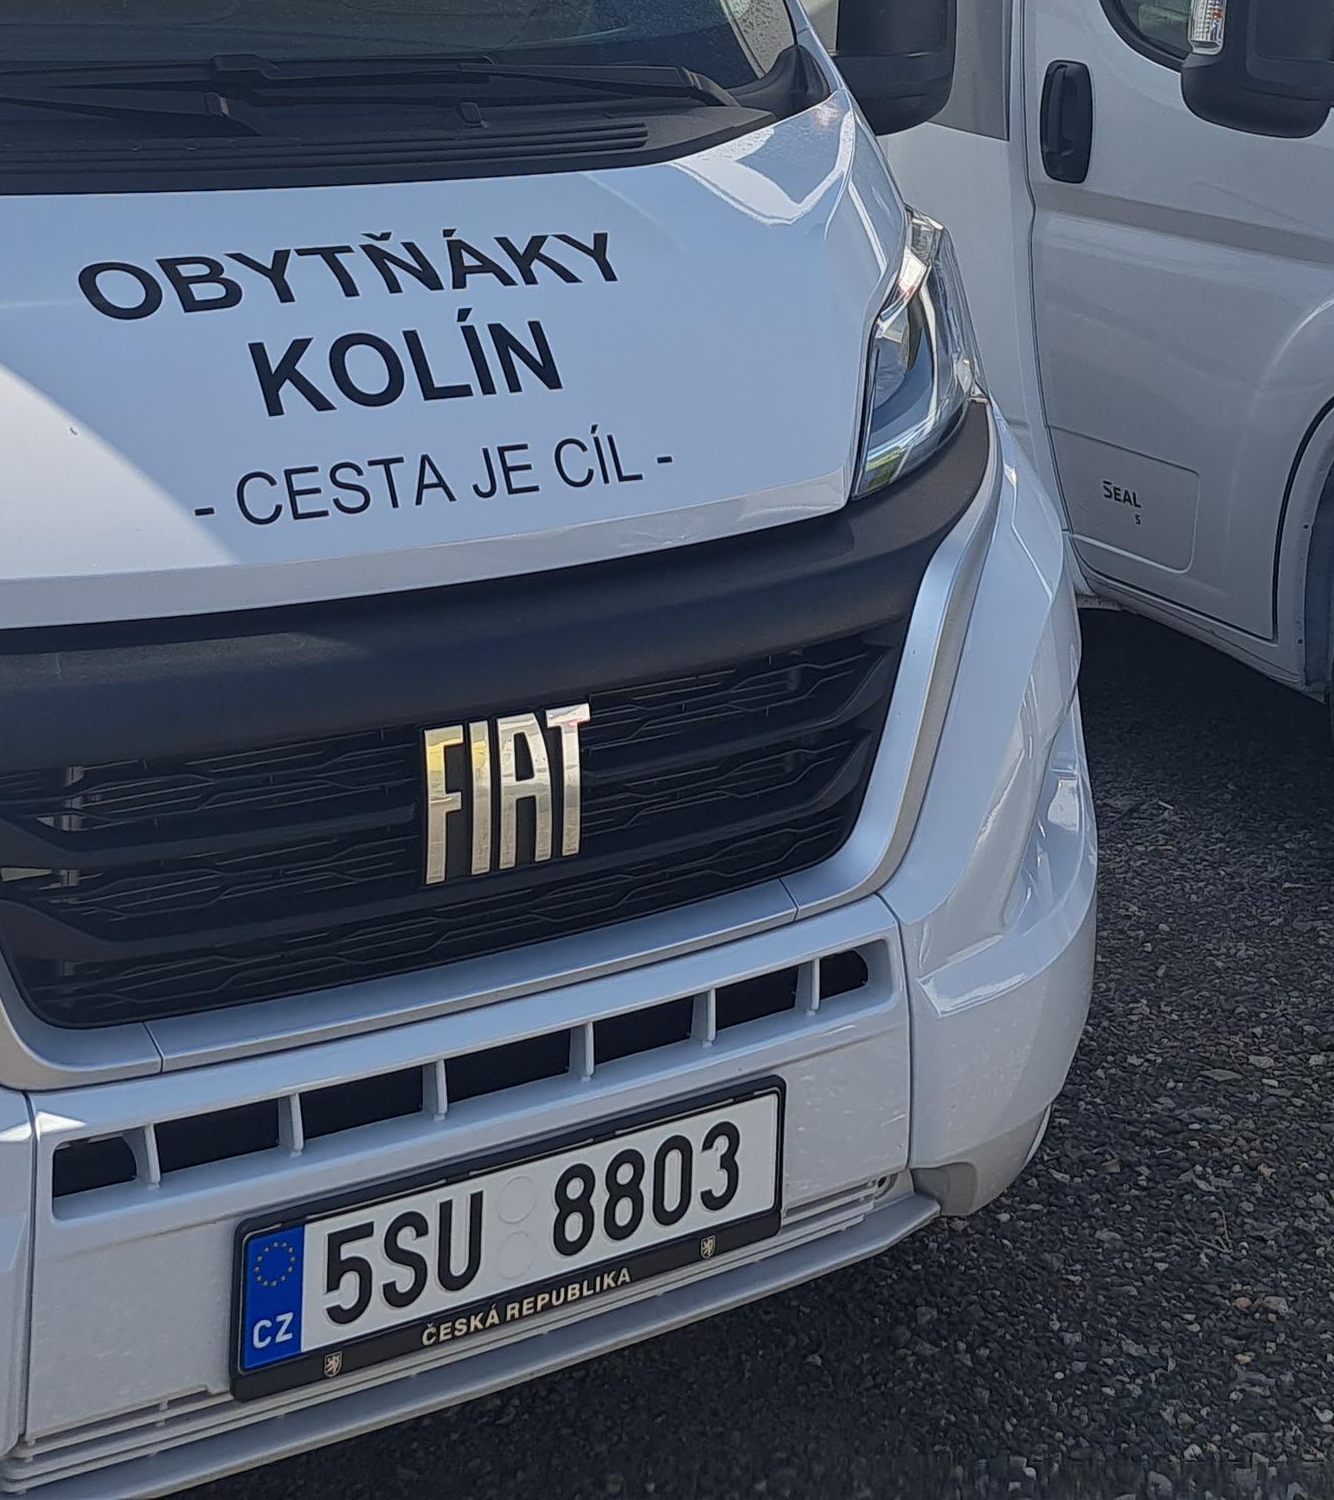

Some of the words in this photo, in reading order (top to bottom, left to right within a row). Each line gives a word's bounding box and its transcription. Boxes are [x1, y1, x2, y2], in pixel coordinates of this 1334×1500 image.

[77, 228, 618, 320] OBYTŇÁKY
[247, 307, 564, 418] KOLÍN
[235, 453, 457, 526] CESTA
[471, 443, 541, 500] JE
[553, 424, 643, 488] CÍL
[424, 703, 591, 885] FIAT
[325, 1190, 485, 1325] 5SU
[552, 1121, 741, 1257] 8803
[251, 1311, 294, 1350] CZ
[422, 1303, 501, 1346] ČESKÁ
[506, 1267, 632, 1322] REPUBLIKA
